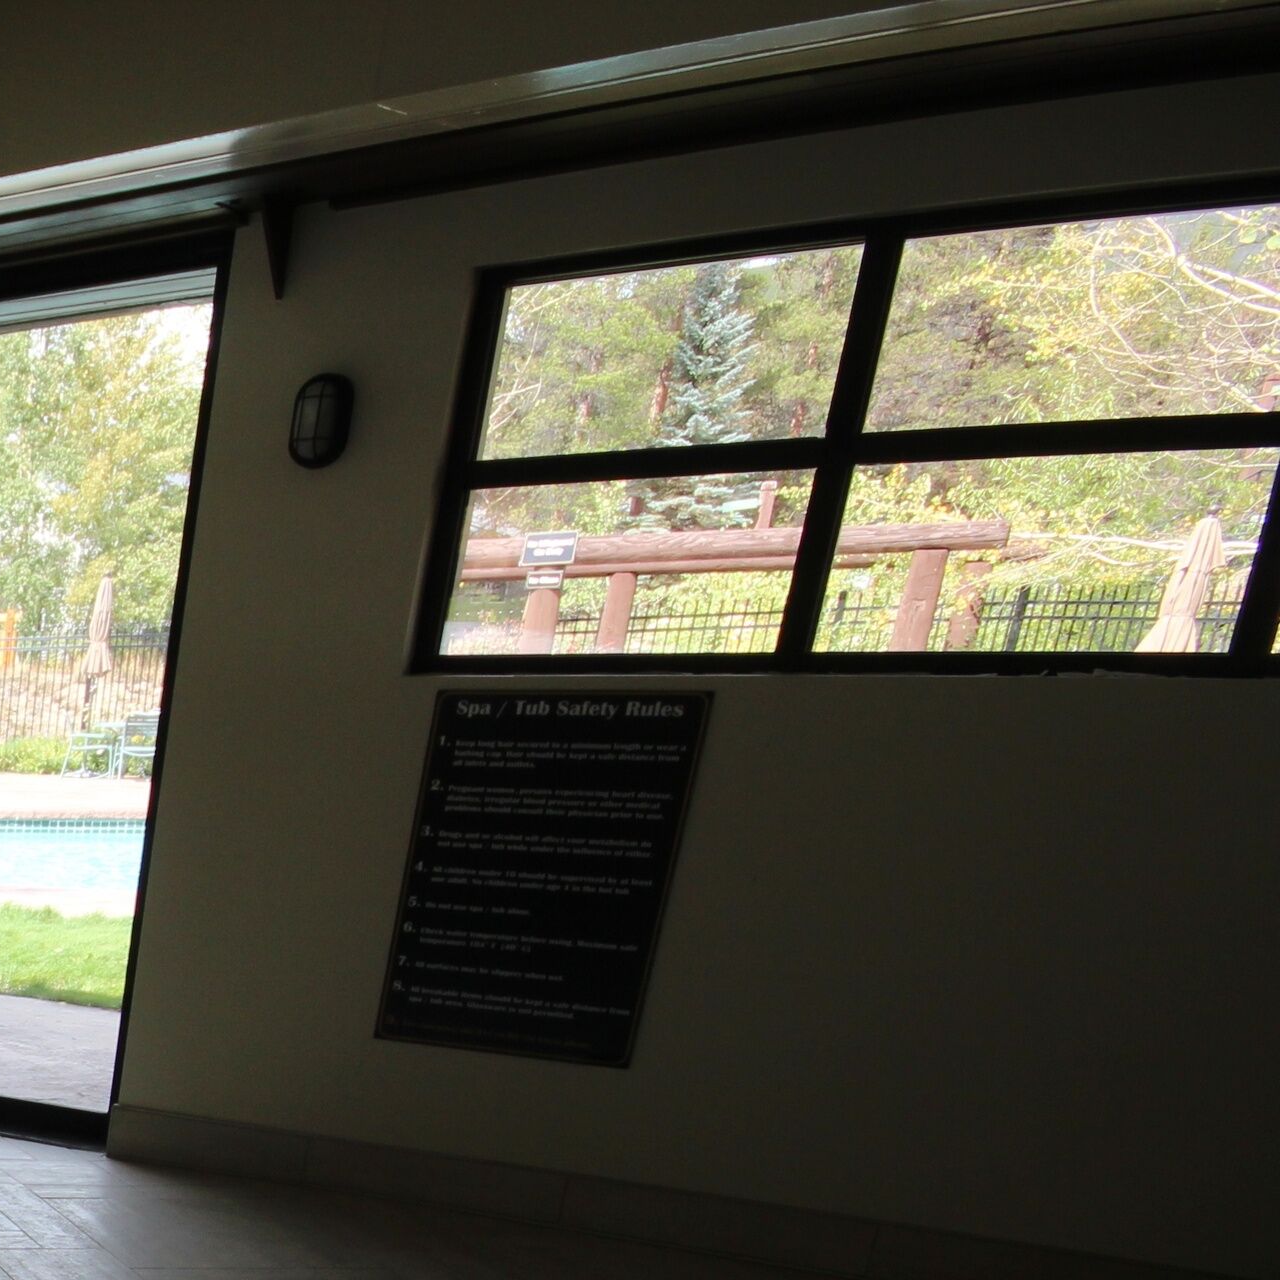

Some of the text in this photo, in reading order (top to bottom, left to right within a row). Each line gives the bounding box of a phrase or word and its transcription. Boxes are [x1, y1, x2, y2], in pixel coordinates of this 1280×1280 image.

[456, 699, 686, 719] Spa / Tub Safety Rules
[439, 735, 451, 747] 1.
[430, 778, 444, 791] 2.
[420, 824, 434, 837] 3.
[415, 861, 427, 873] 4.
[408, 895, 421, 908] 5.
[403, 921, 416, 934] 6.
[398, 955, 410, 967] 7.
[393, 979, 405, 991] 8.
